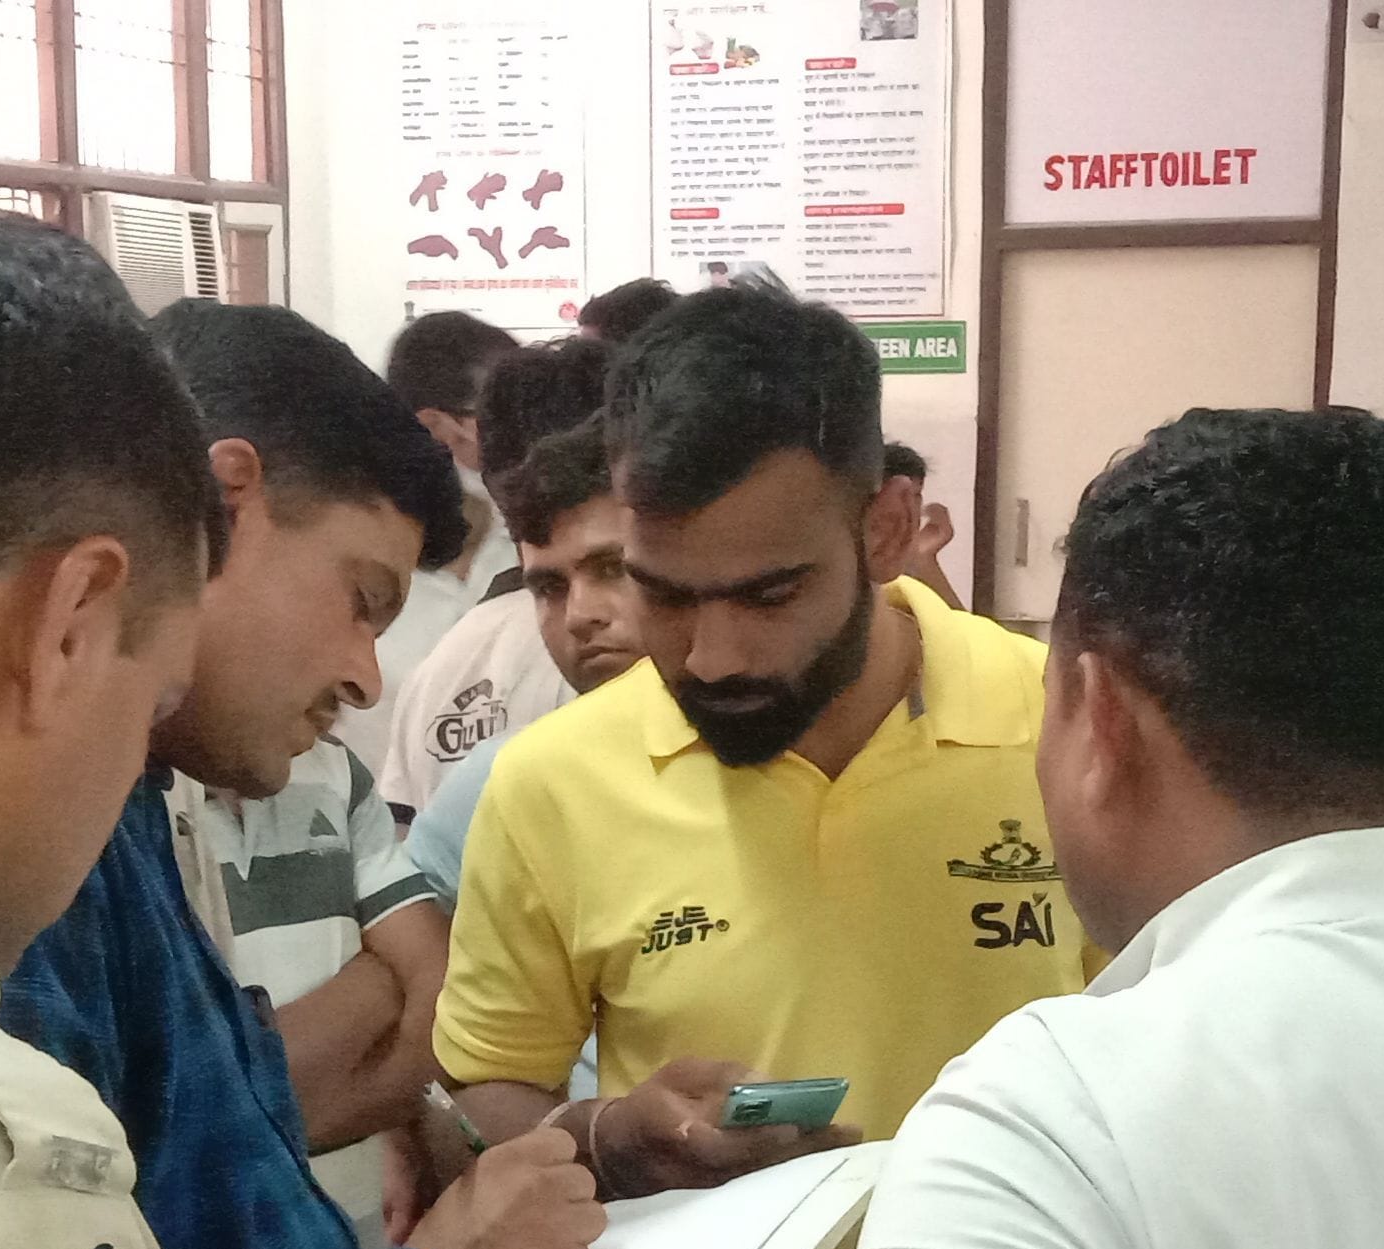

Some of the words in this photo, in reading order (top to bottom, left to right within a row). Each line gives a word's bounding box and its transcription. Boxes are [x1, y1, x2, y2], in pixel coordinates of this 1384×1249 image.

[1043, 148, 1258, 191] STAFFTOILET
[874, 337, 911, 359] EEN
[914, 336, 958, 358] AREA
[971, 900, 1056, 950] SAI
